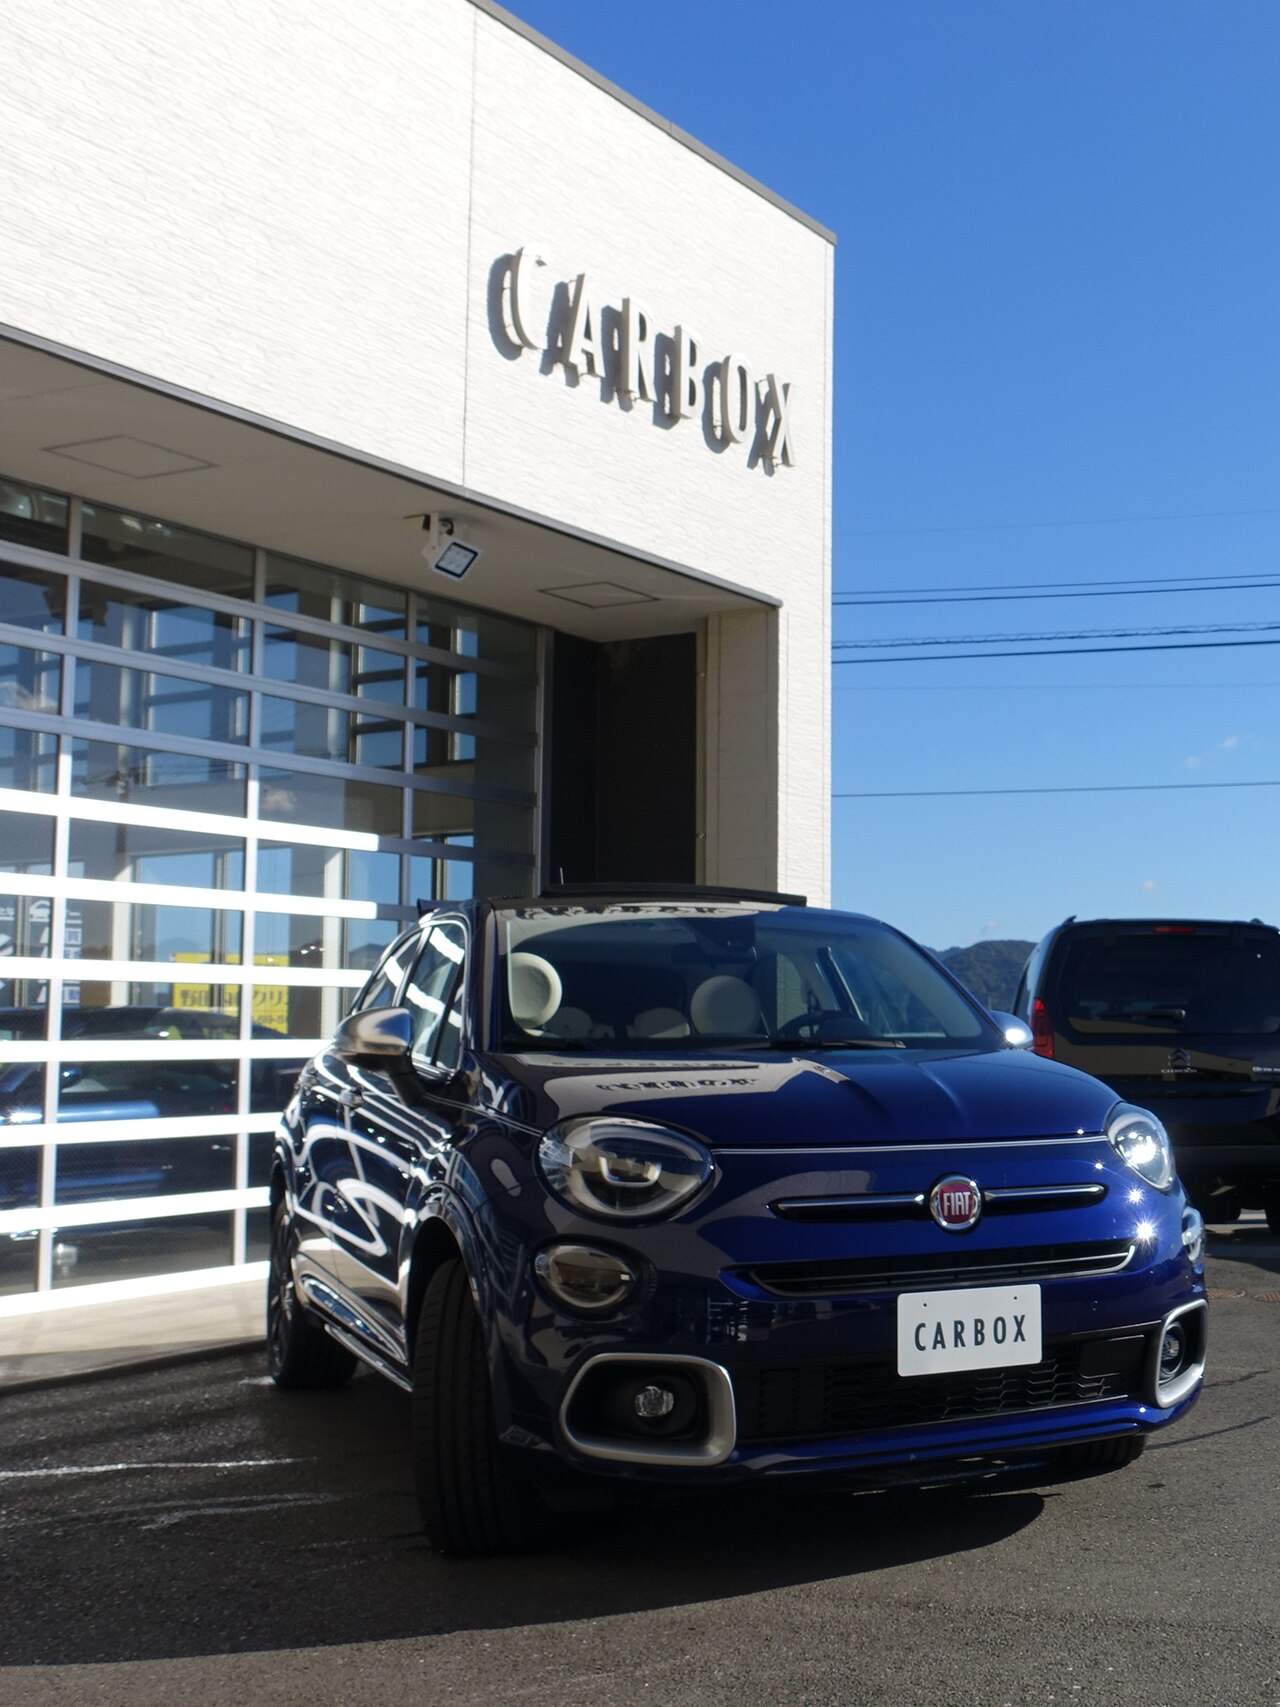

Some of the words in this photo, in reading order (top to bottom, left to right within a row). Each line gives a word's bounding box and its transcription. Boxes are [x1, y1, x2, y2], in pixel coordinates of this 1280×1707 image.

[508, 245, 796, 470] CARBOX
[943, 1191, 971, 1216] FIAT
[914, 1315, 1027, 1351] CARBOX
